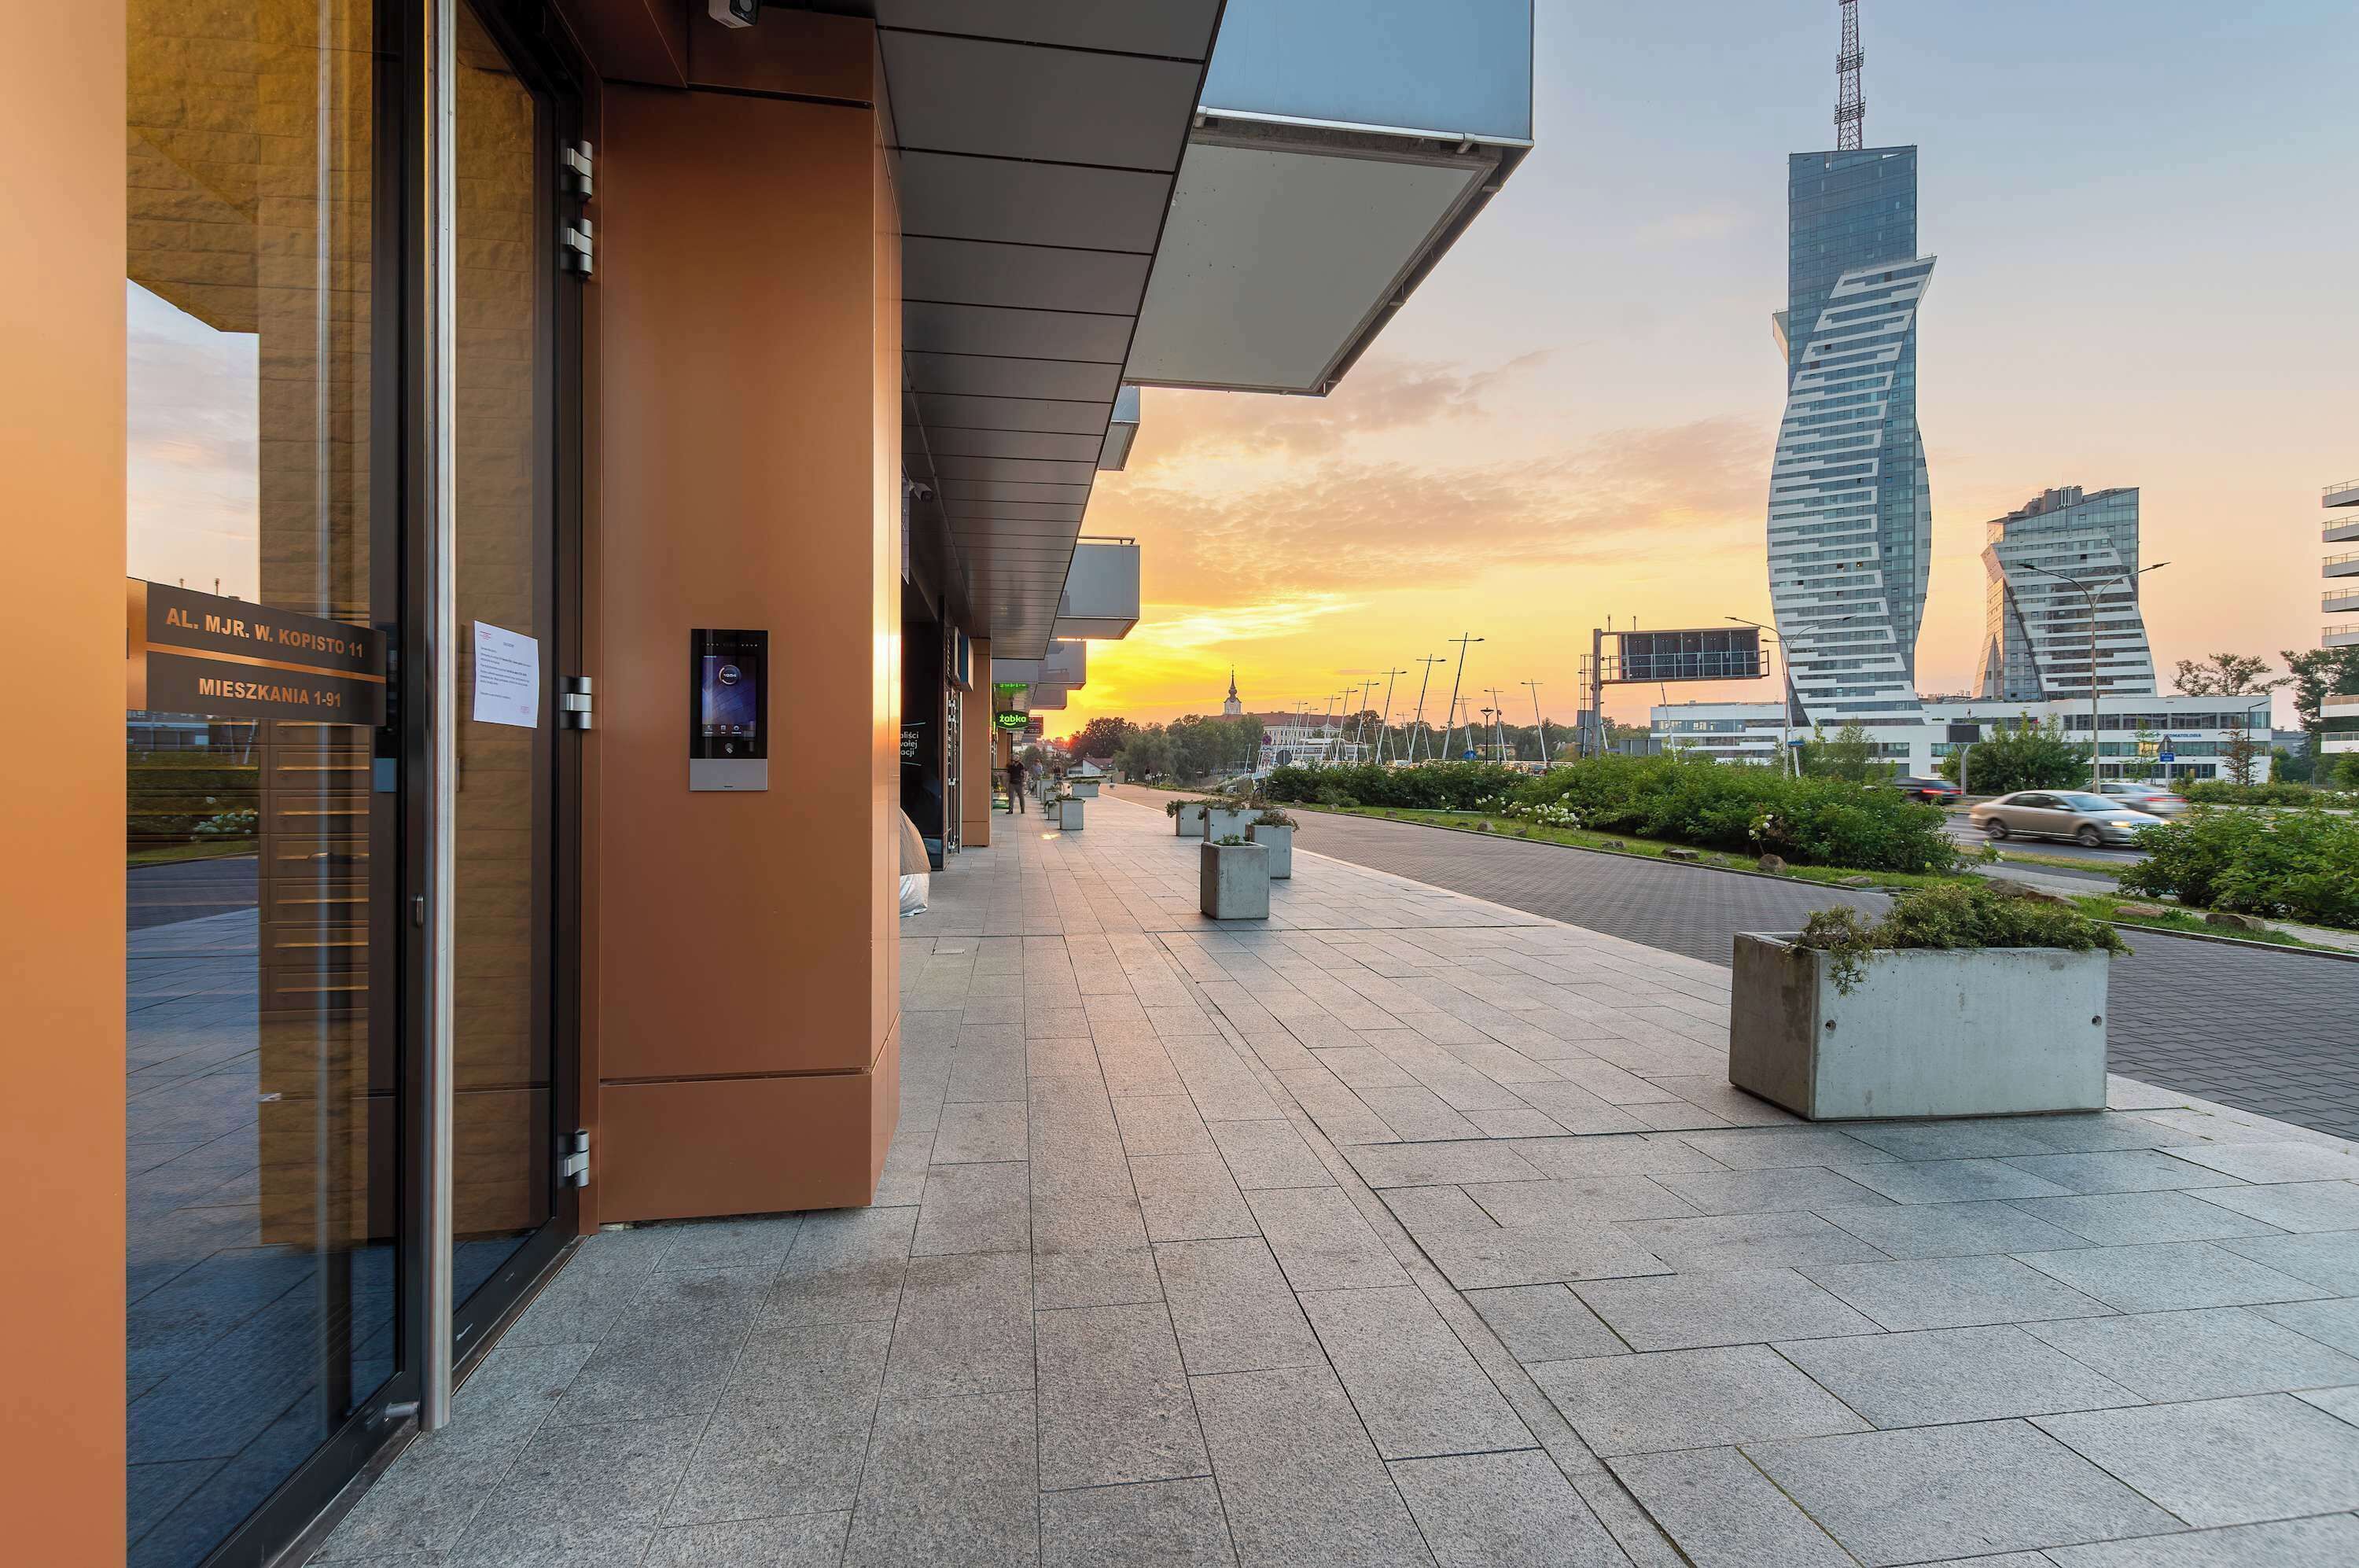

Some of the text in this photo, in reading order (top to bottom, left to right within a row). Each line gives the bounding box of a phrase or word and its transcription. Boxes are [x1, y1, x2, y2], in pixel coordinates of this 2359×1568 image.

[166, 607, 363, 657] AL. MJR. W. KOPISTO 11
[199, 678, 340, 708] MIESZKANIA 1-91
[999, 714, 1027, 723] żabka
